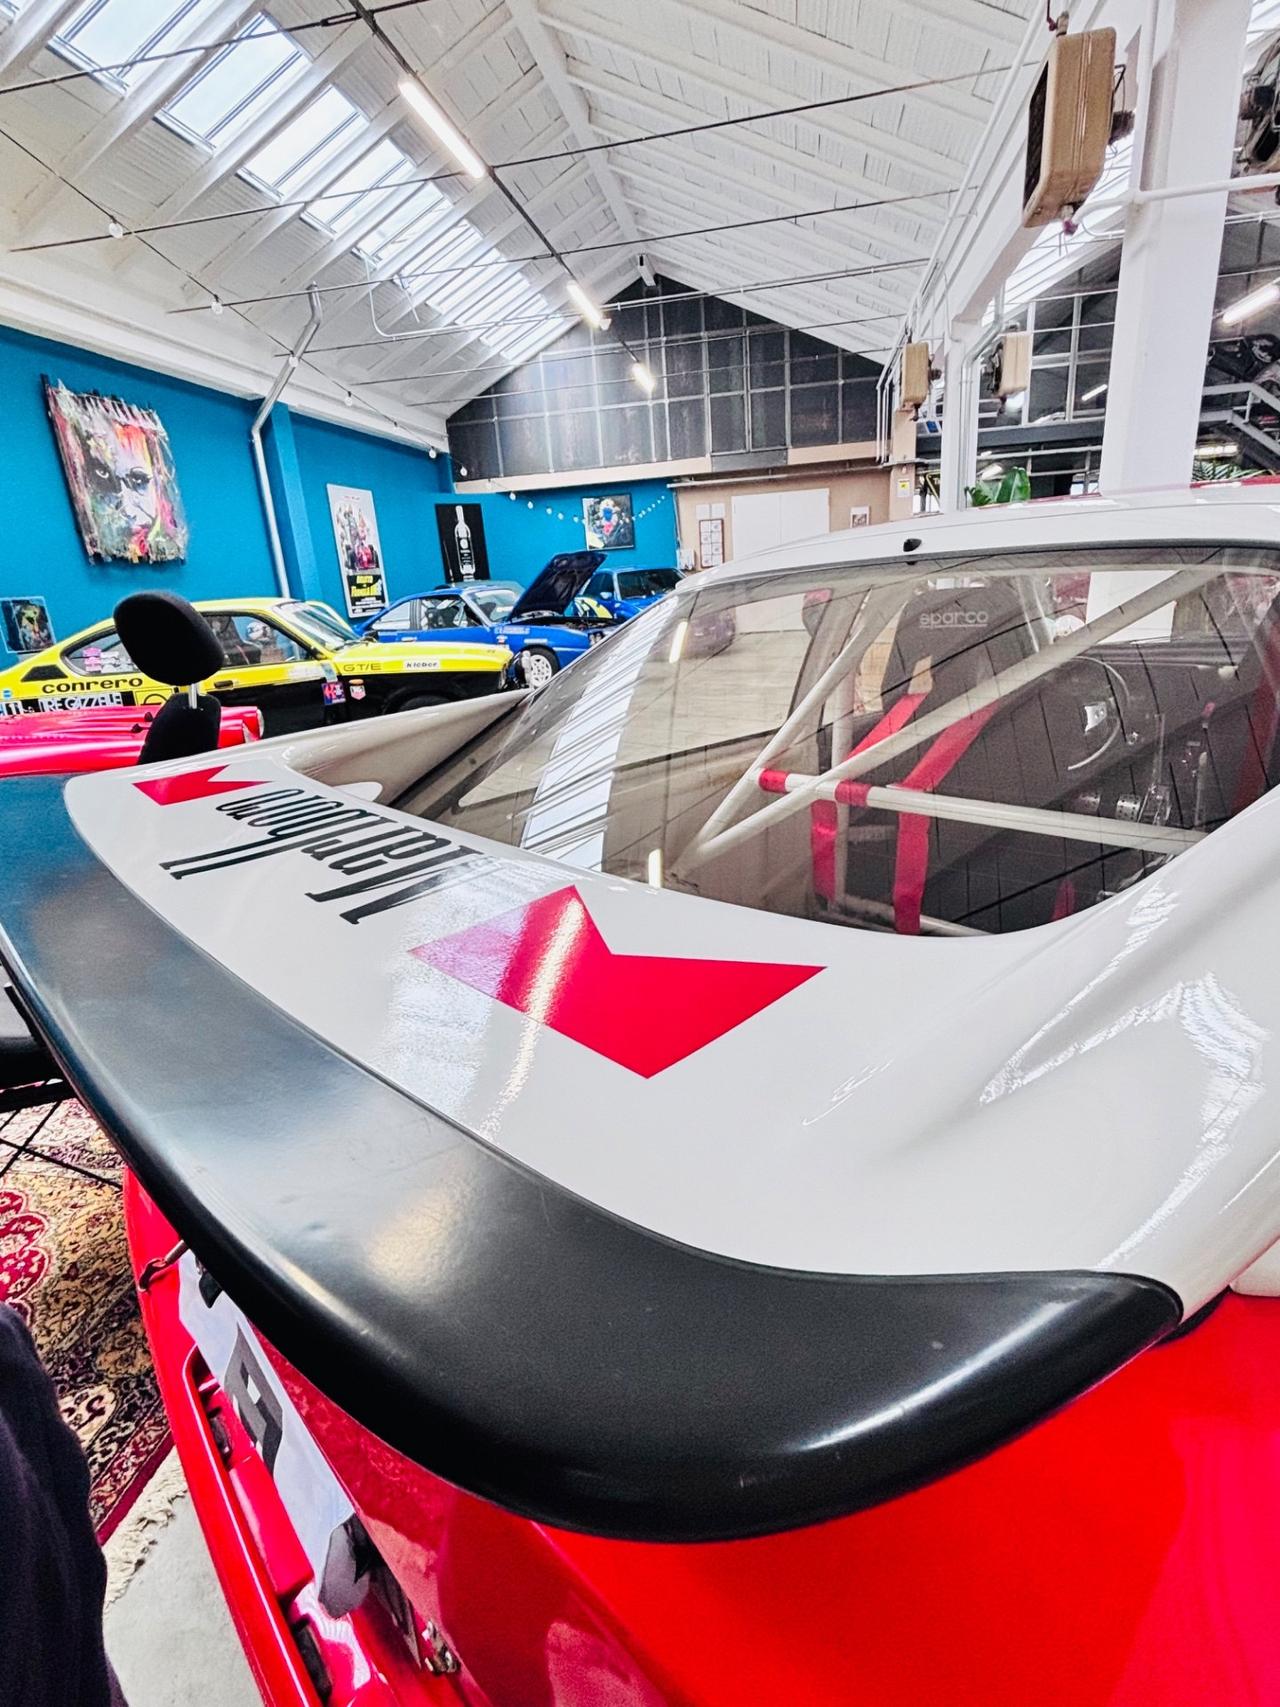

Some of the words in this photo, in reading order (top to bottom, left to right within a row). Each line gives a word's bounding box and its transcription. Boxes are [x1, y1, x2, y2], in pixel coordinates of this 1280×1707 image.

[919, 611, 989, 629] sparco
[42, 678, 143, 694] conrero
[158, 788, 502, 925] Marlboro
